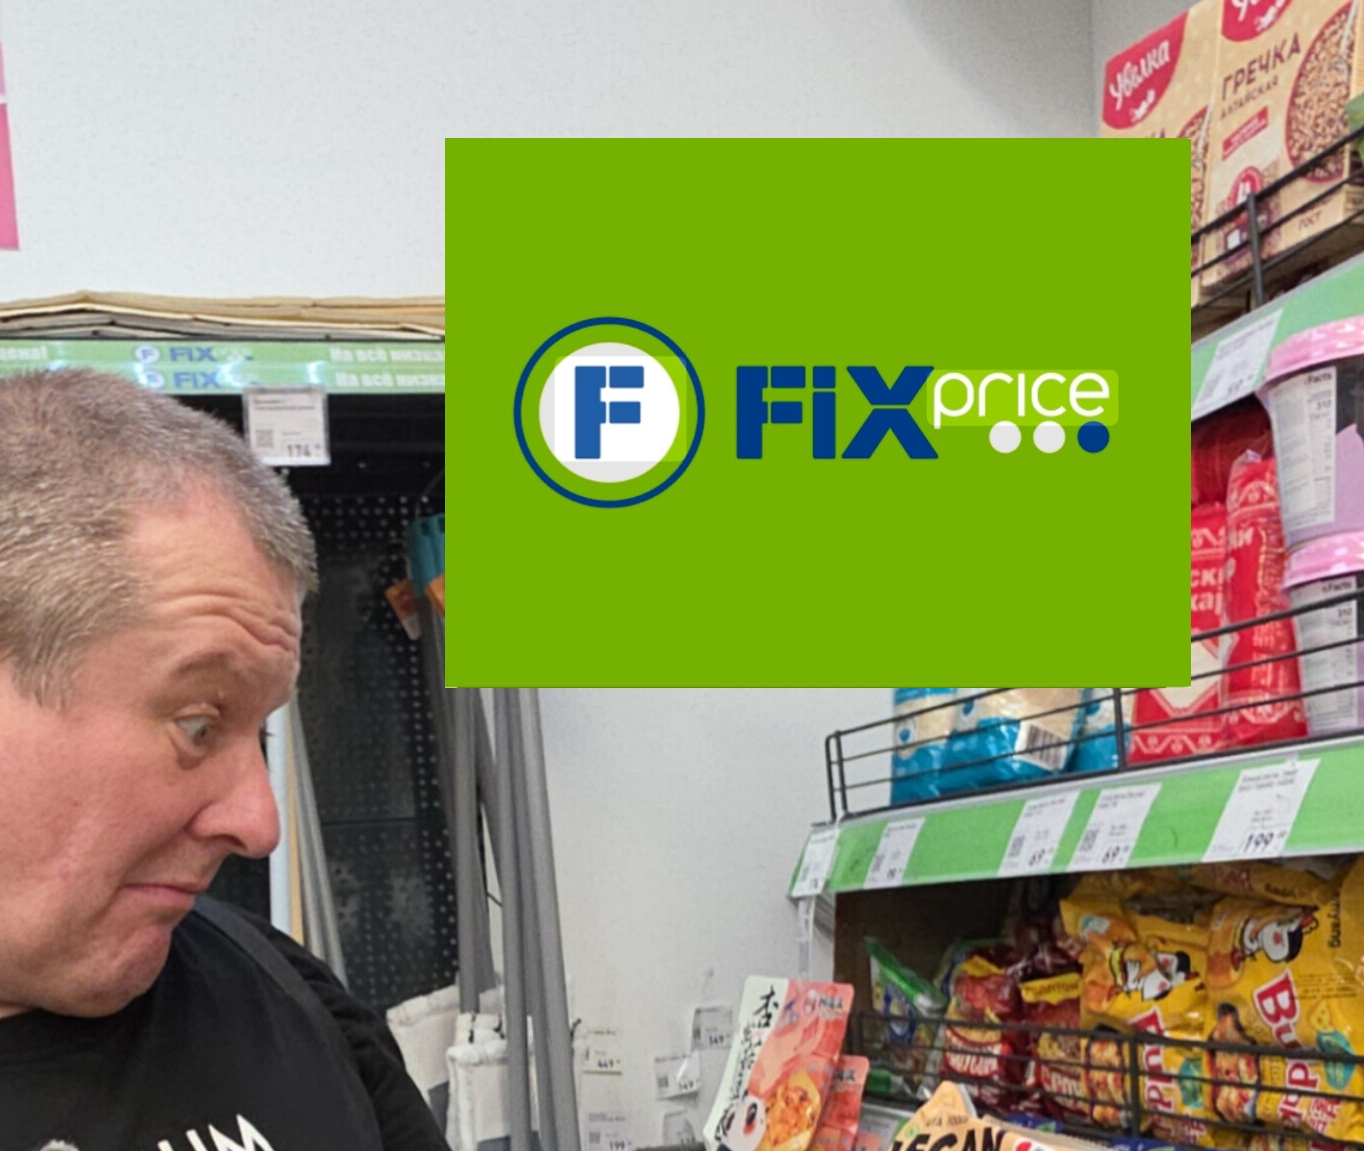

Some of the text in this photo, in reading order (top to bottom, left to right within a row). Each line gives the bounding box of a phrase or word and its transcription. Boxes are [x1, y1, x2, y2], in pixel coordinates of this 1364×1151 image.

[1221, 32, 1301, 100] ГРЕЧКА
[286, 444, 312, 458] 174
[1242, 832, 1274, 853] 199
